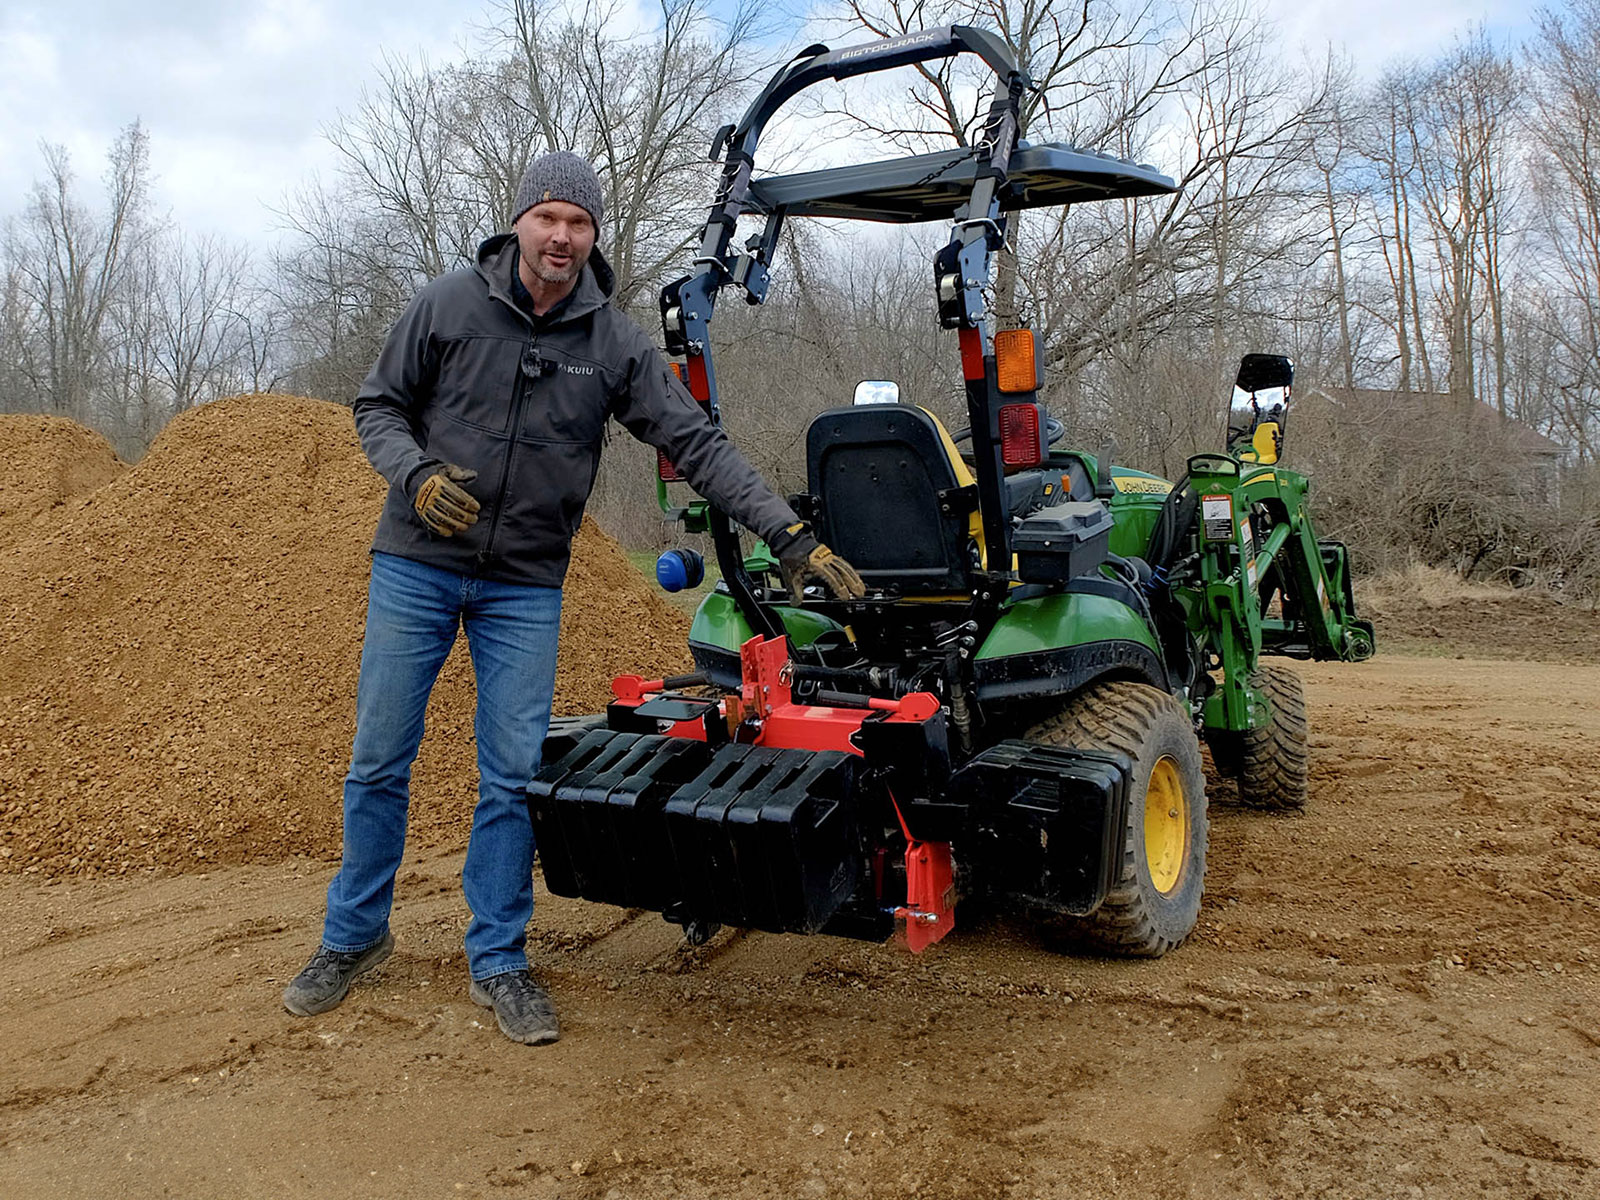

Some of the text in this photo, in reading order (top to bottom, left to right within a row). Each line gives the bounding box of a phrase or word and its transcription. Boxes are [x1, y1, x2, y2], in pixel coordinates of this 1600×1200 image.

[841, 33, 935, 59] BIGTOOLRACK
[567, 366, 594, 376] KUIU
[1123, 480, 1168, 494] JOHN DEERE
